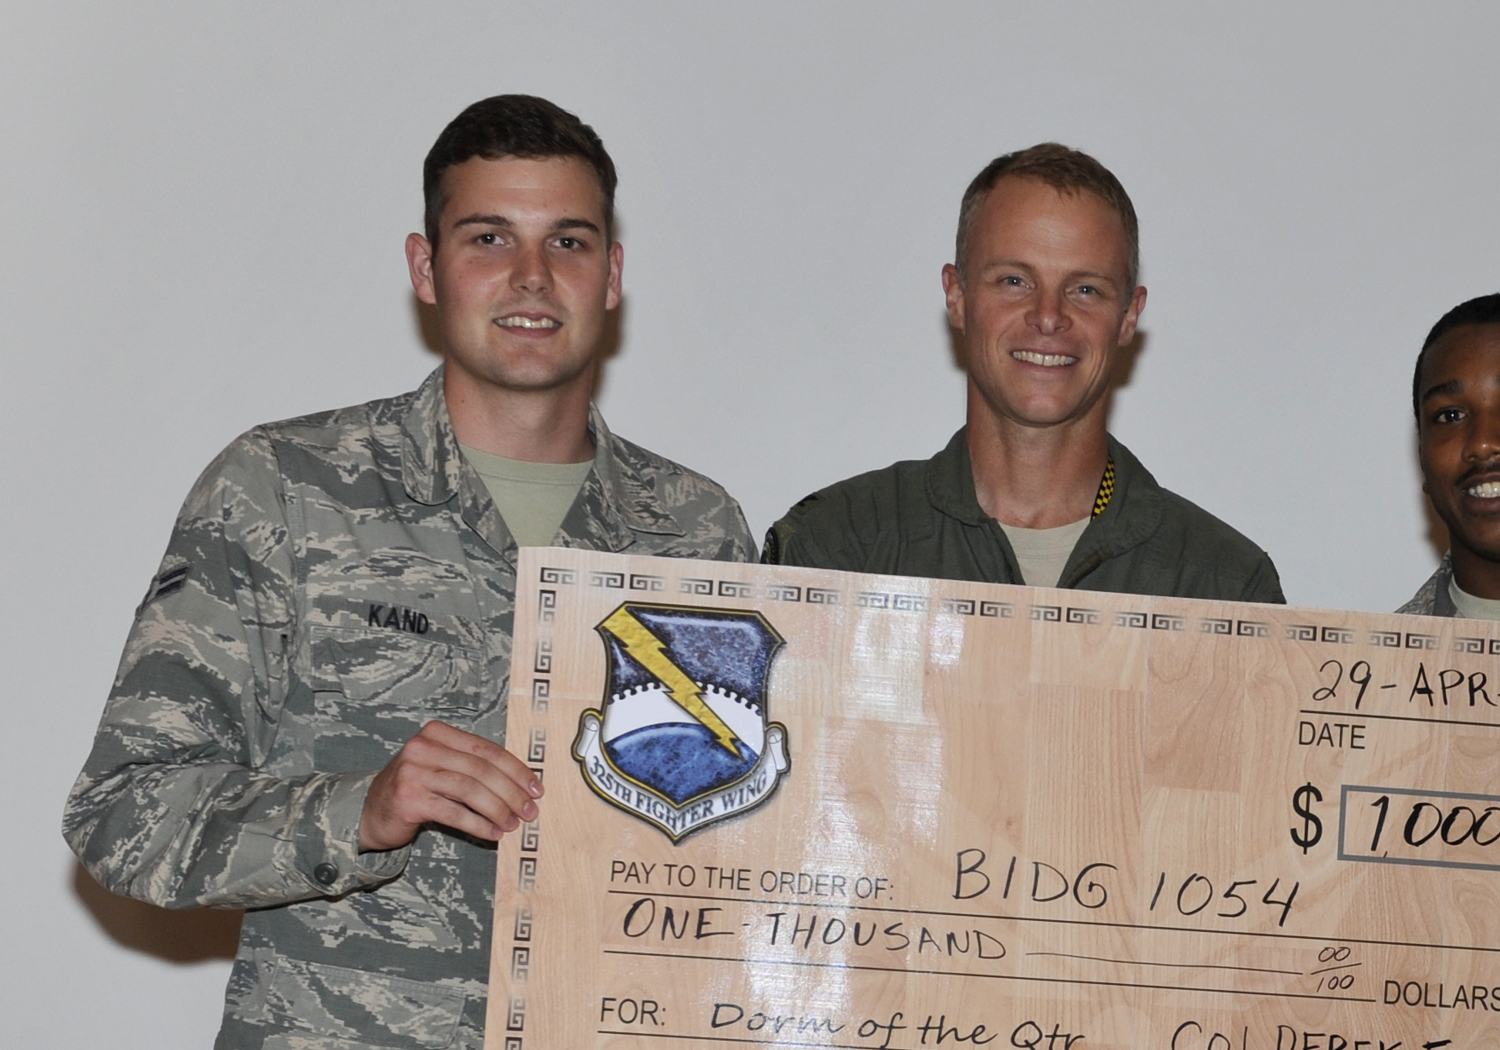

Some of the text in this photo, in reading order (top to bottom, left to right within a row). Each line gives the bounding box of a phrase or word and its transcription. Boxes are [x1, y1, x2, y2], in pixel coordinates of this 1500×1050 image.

[368, 603, 429, 635] KAND
[1298, 720, 1366, 750] DATE
[590, 755, 767, 831] 325TH FIGHTER WING
[1290, 782, 1323, 855] $
[610, 860, 894, 901] PAY TO THE ORDER OF:
[1149, 872, 1300, 927] 1054
[600, 997, 667, 1026] FOR:
[711, 1003, 845, 1033] Dorm
[857, 1012, 907, 1050] of
[917, 1014, 998, 1045] the
